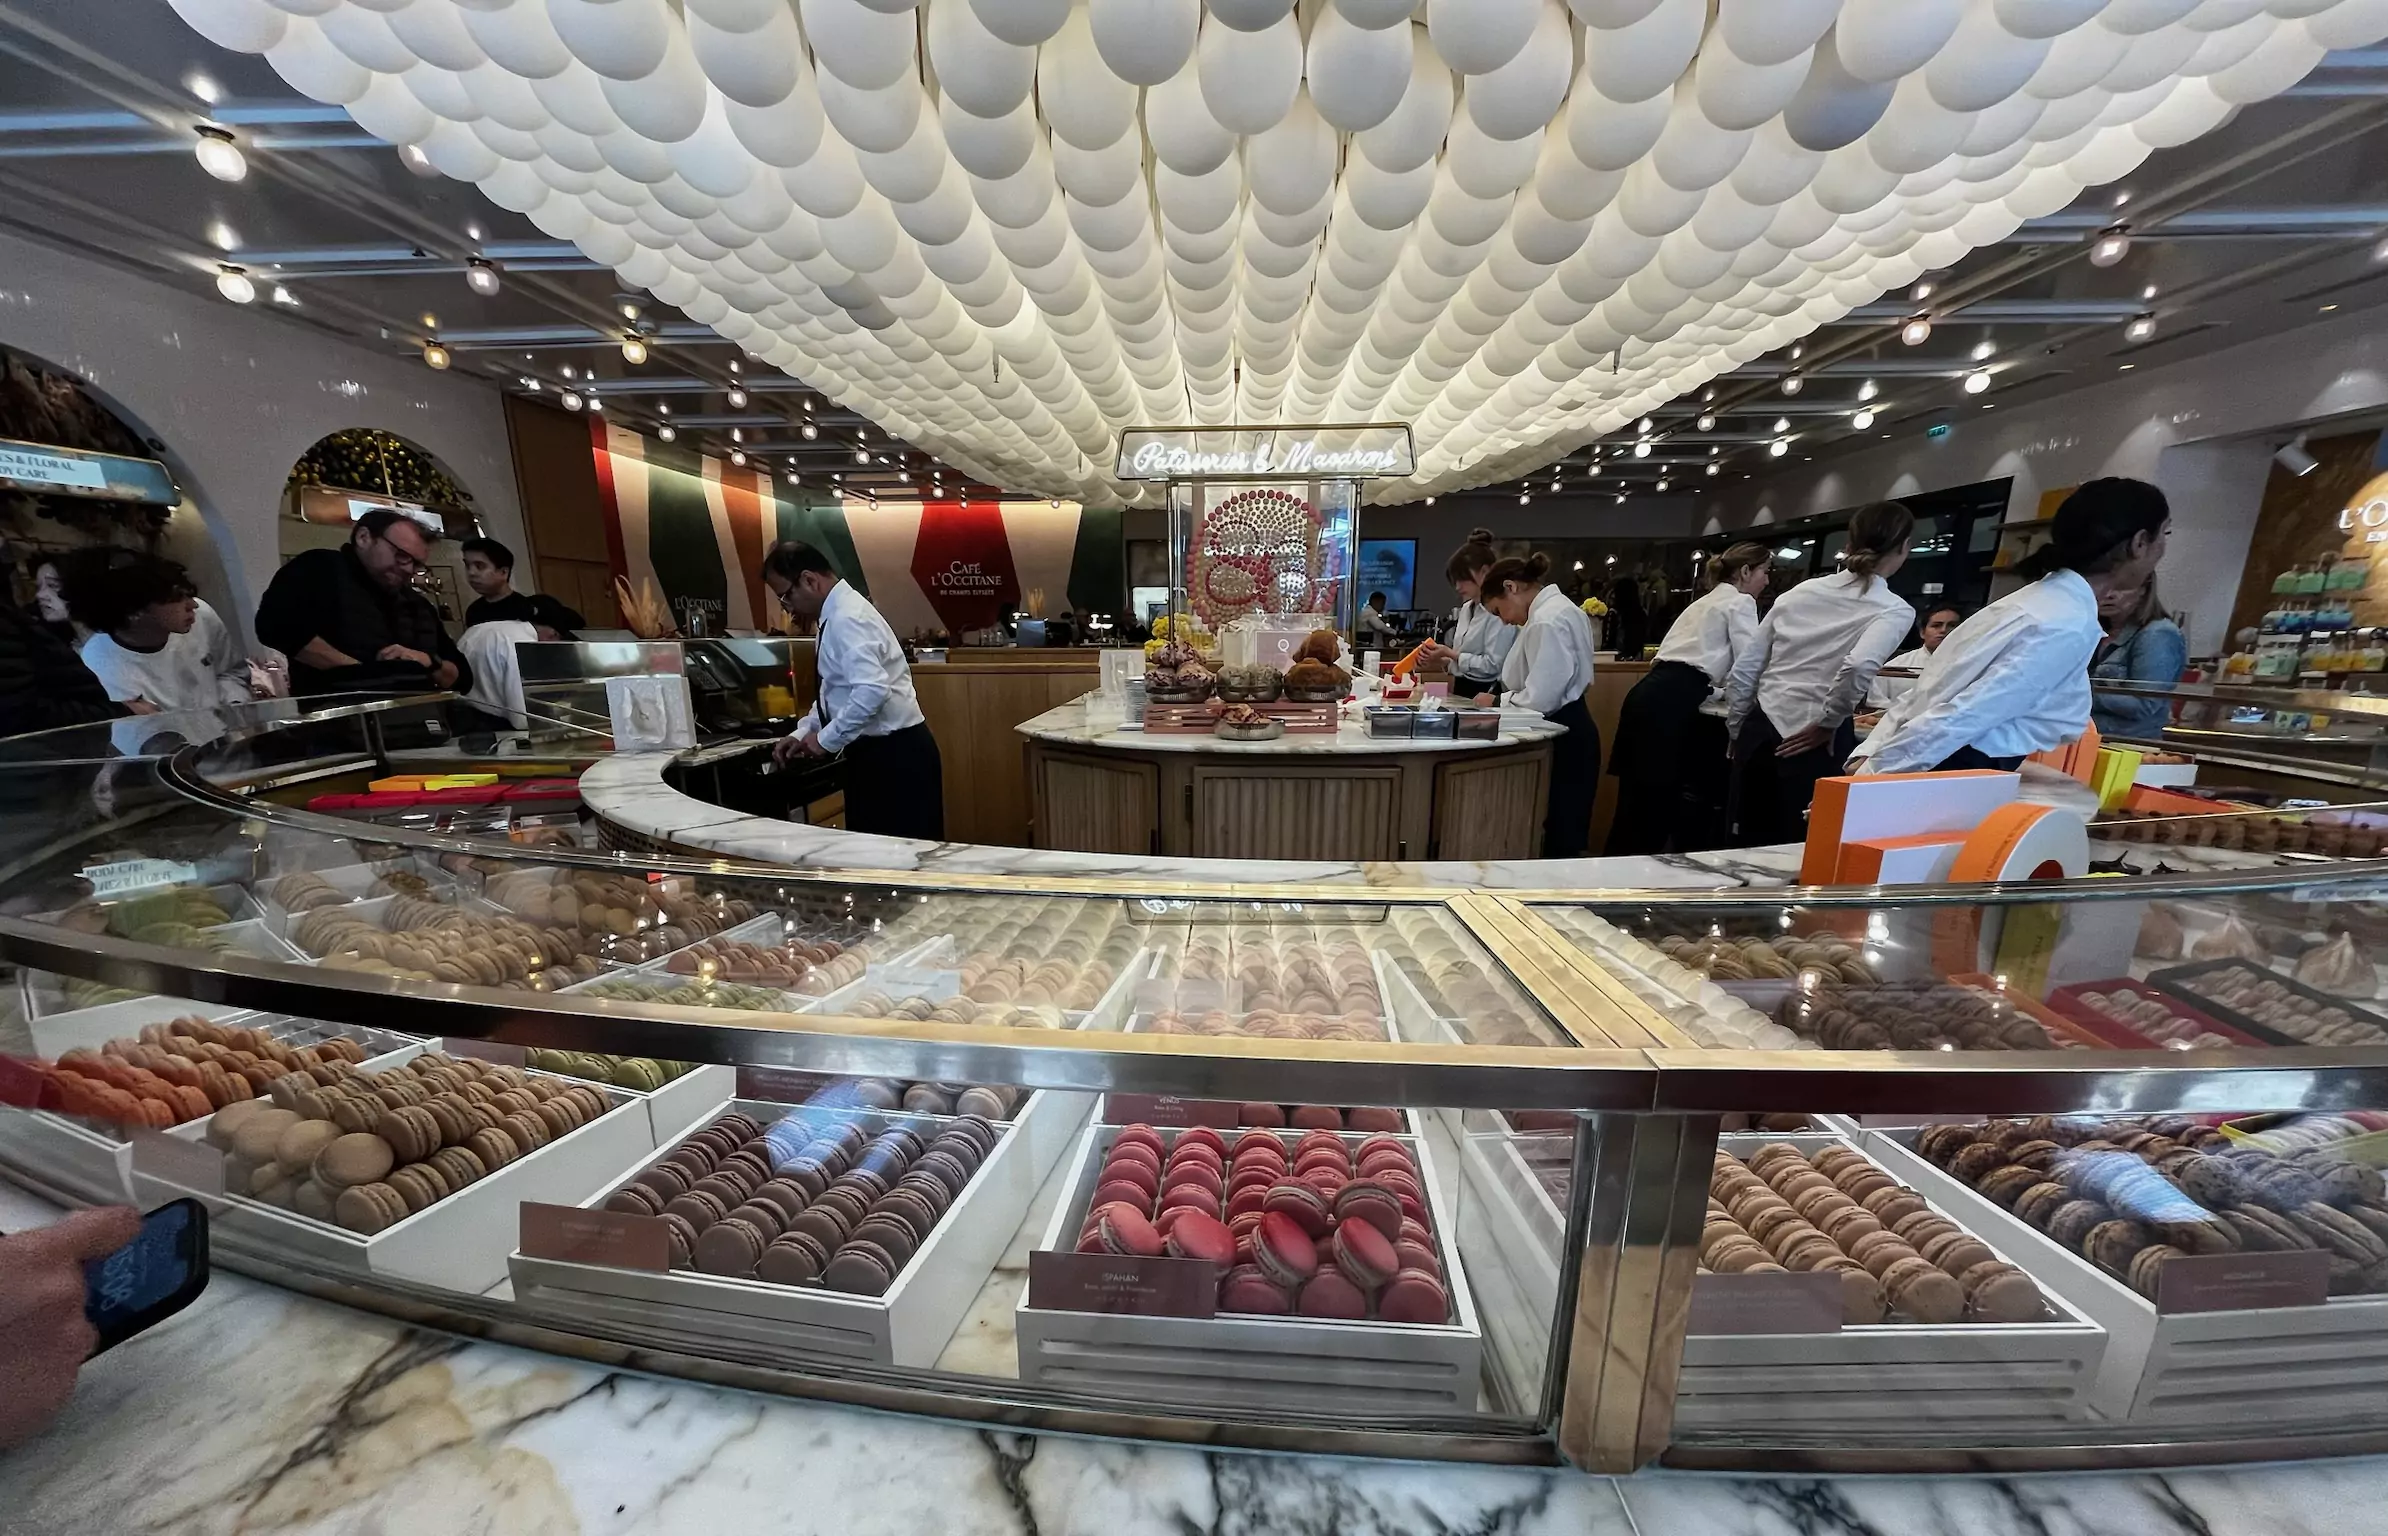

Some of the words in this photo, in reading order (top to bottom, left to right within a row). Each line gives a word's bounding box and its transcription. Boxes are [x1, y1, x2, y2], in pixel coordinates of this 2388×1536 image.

[28, 456, 76, 471] FLORAL
[1253, 443, 1271, 473] &
[1275, 441, 1397, 473] Macarons
[16, 467, 50, 480] CARE
[950, 560, 982, 575] CAFÉ
[931, 572, 1003, 586] L'OCCITANE
[1103, 1272, 1139, 1283] ISPAHAN
